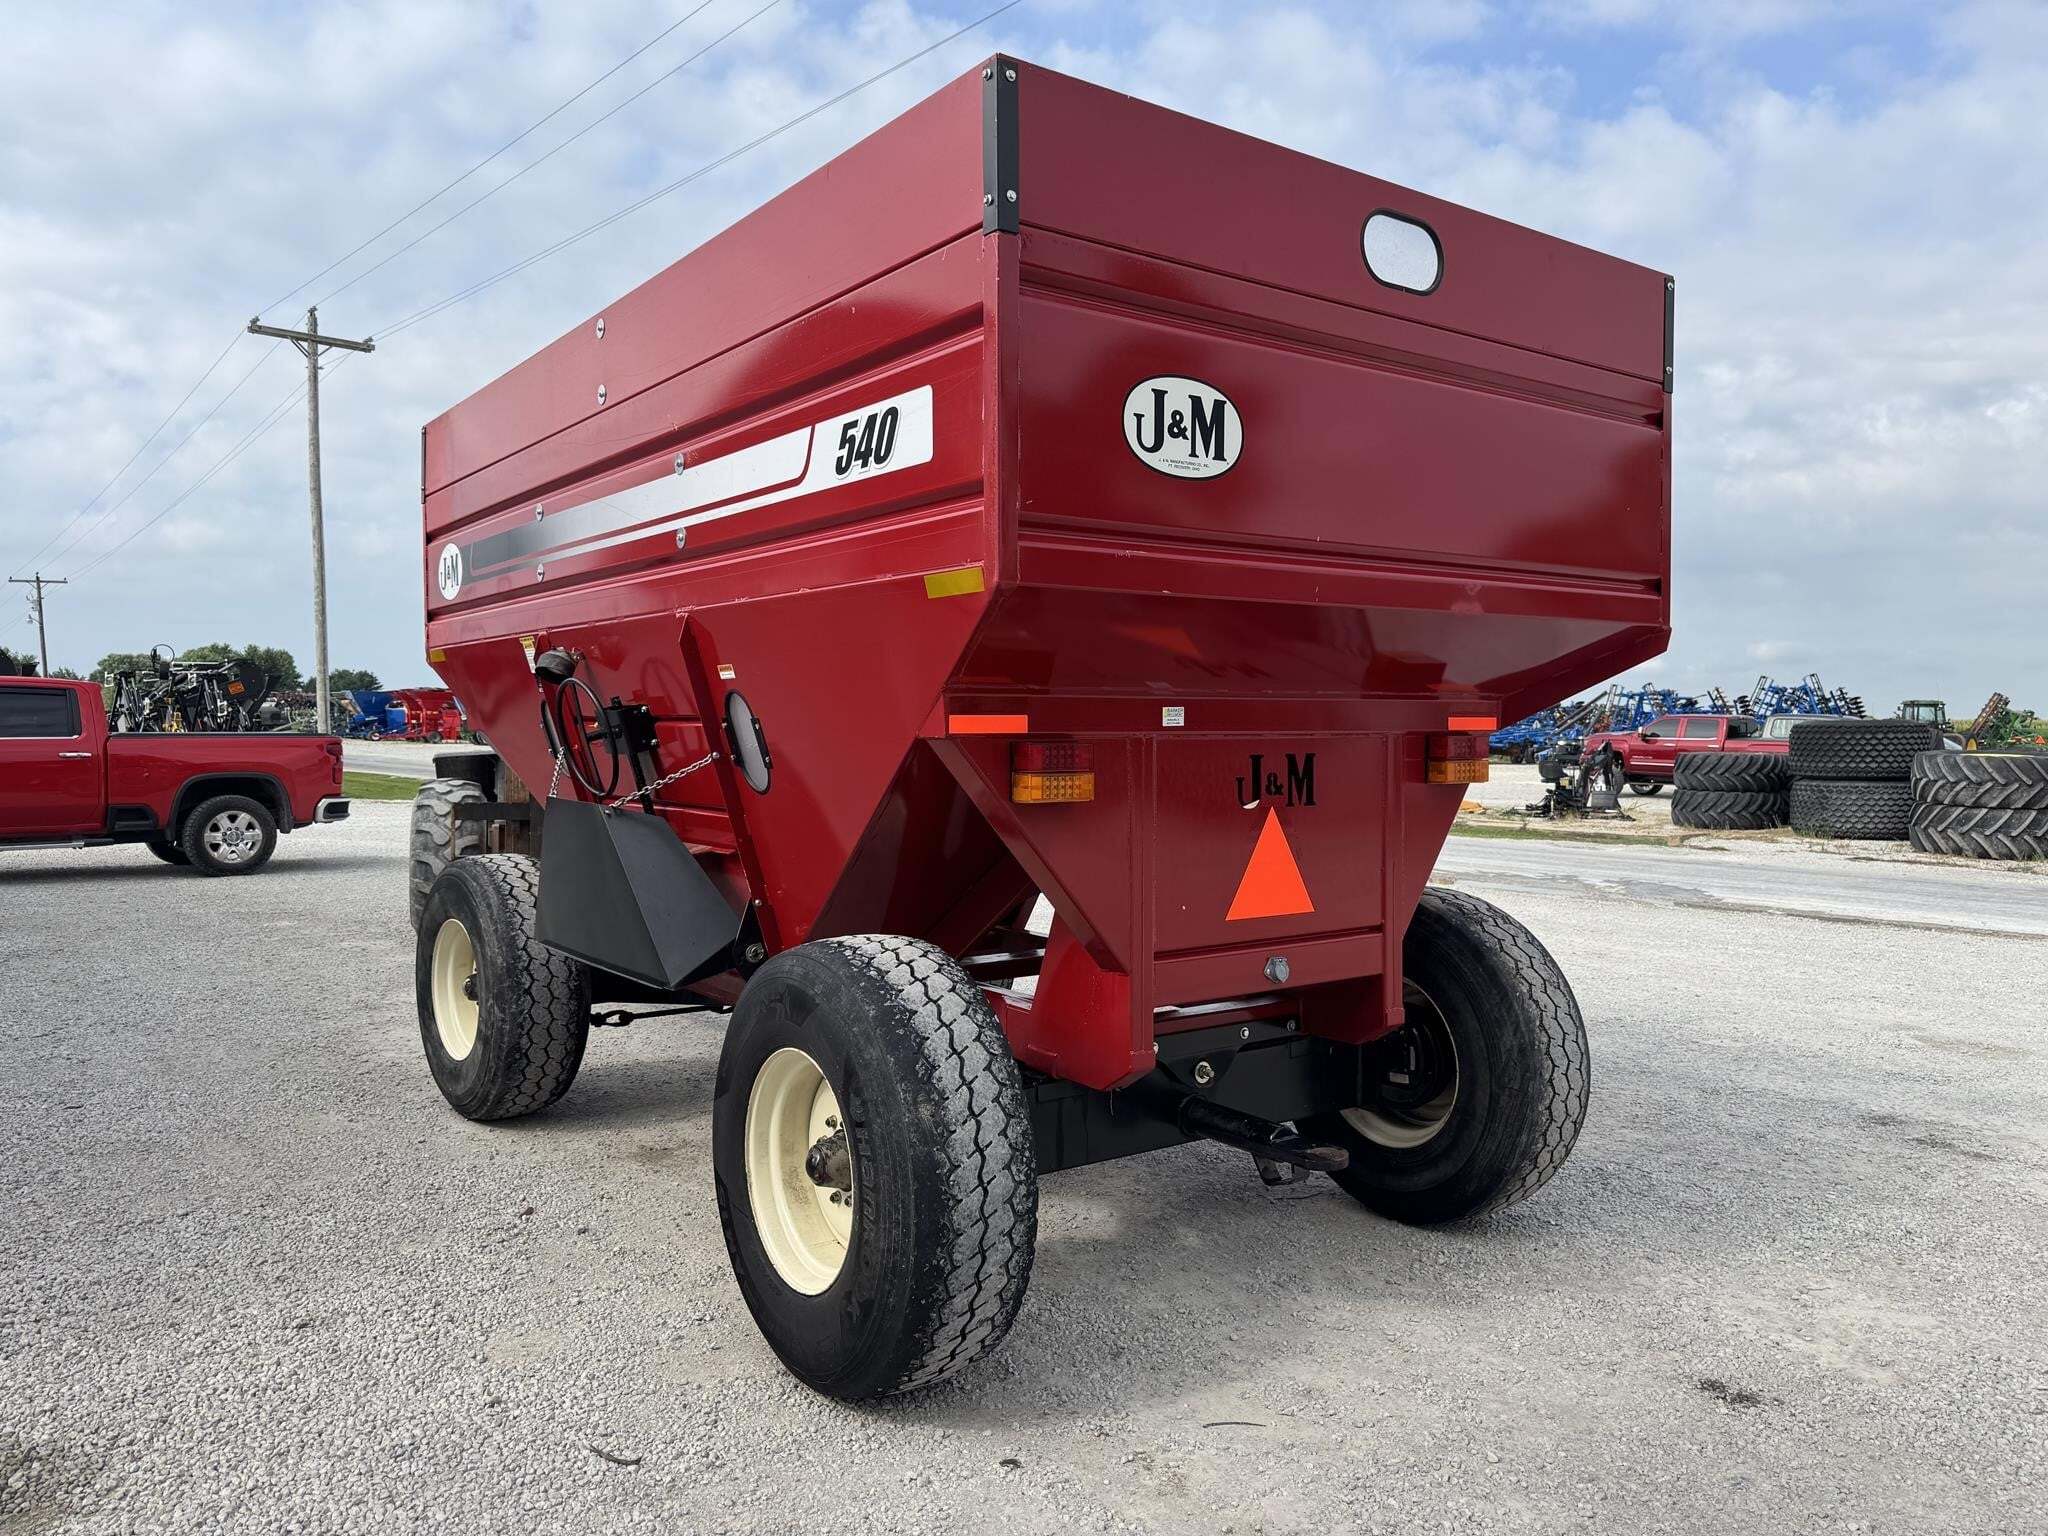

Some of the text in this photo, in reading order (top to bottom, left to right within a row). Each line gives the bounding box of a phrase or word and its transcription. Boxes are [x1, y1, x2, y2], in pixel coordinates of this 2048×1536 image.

[835, 406, 899, 476] 540
[1133, 388, 1227, 462] J&M
[440, 552, 460, 591] J&M
[1235, 752, 1317, 810] J&M
